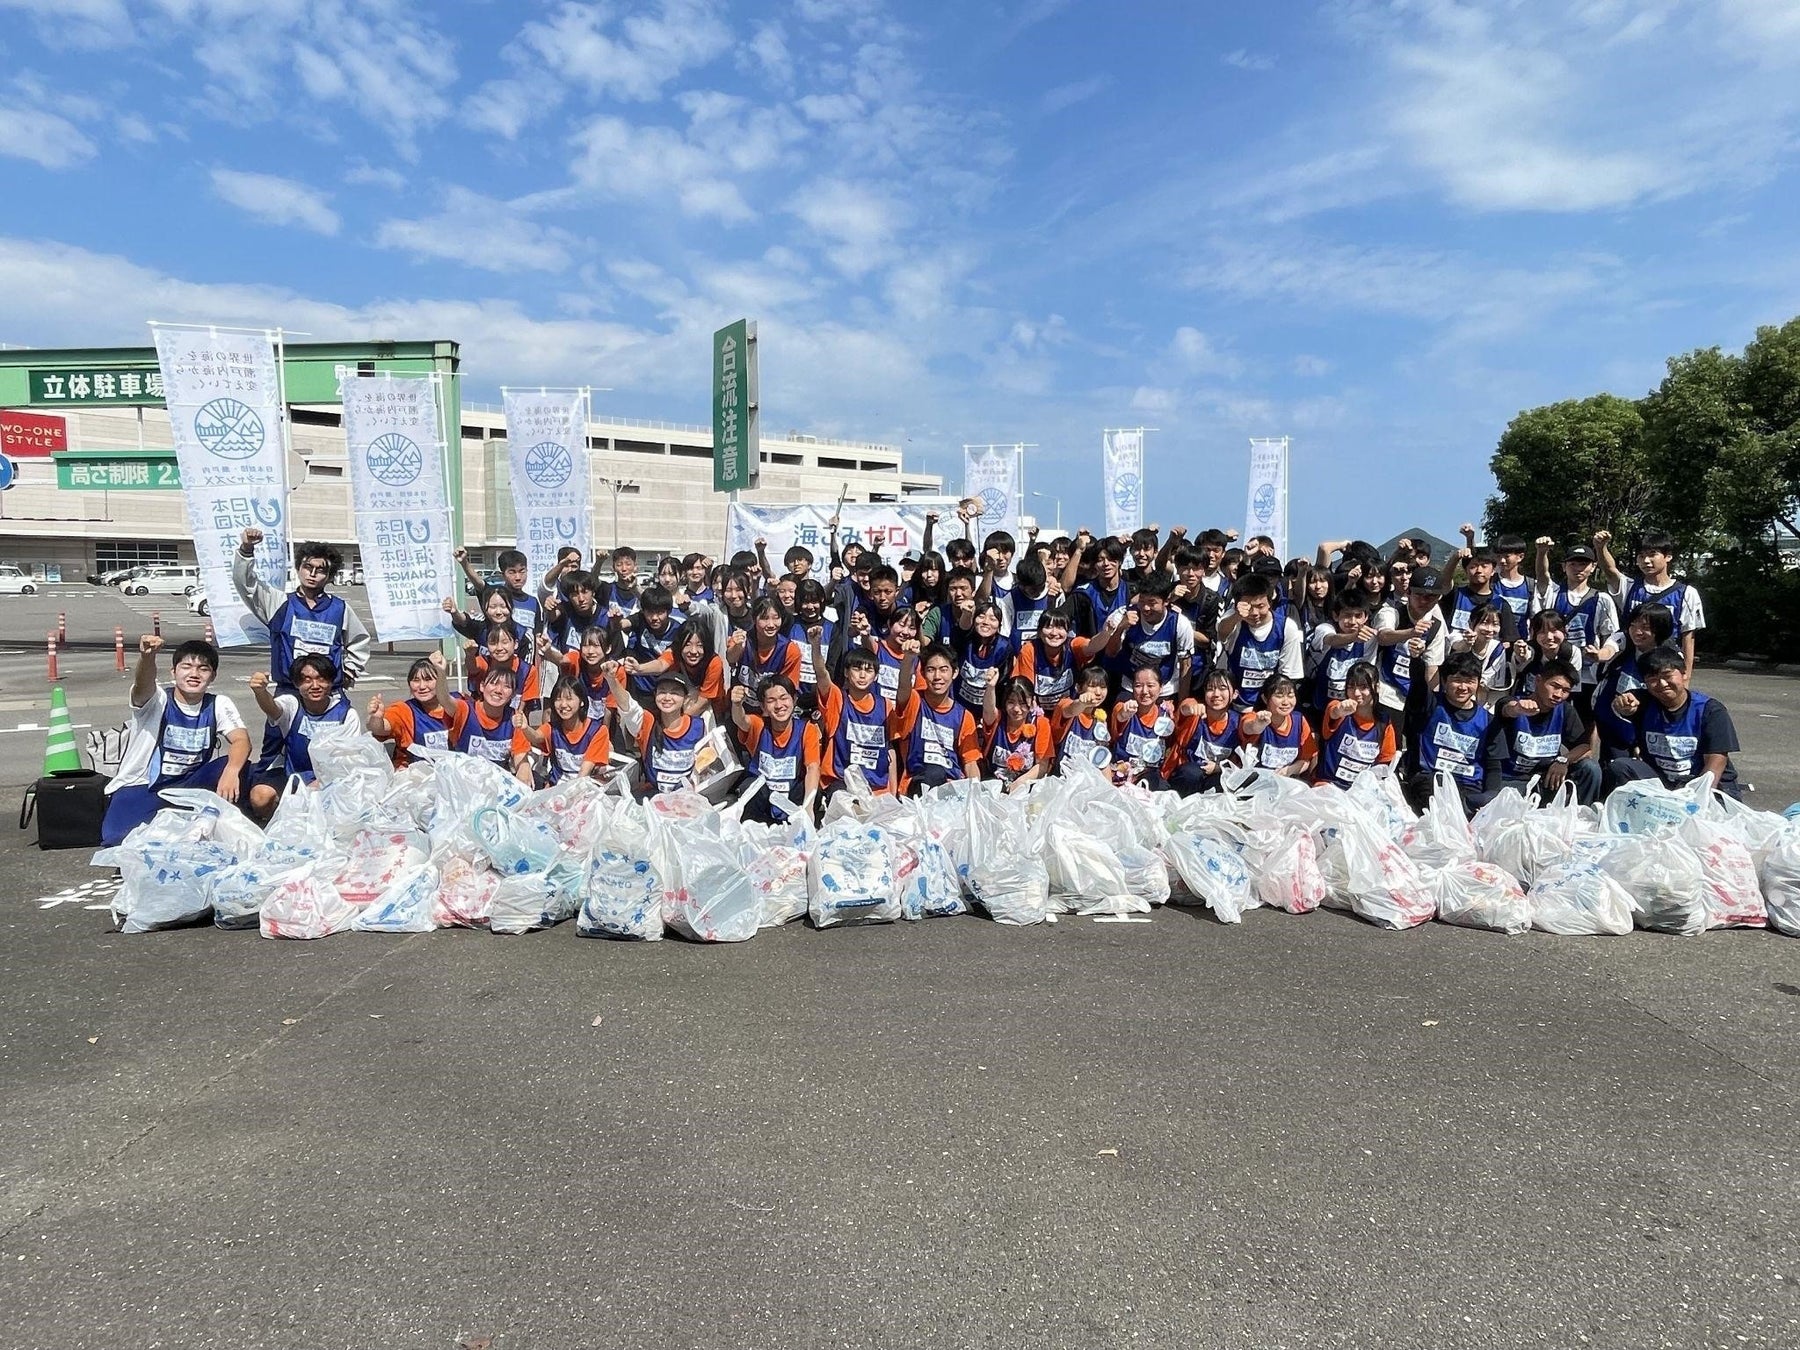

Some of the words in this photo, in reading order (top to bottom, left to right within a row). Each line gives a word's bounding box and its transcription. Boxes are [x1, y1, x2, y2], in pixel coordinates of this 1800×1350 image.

[43, 373, 165, 399] 立体駐車場
[722, 336, 738, 481] 合流注意
[6, 435, 53, 447] STYLE
[69, 462, 149, 485] 高さ制限
[157, 462, 181, 485] 2.
